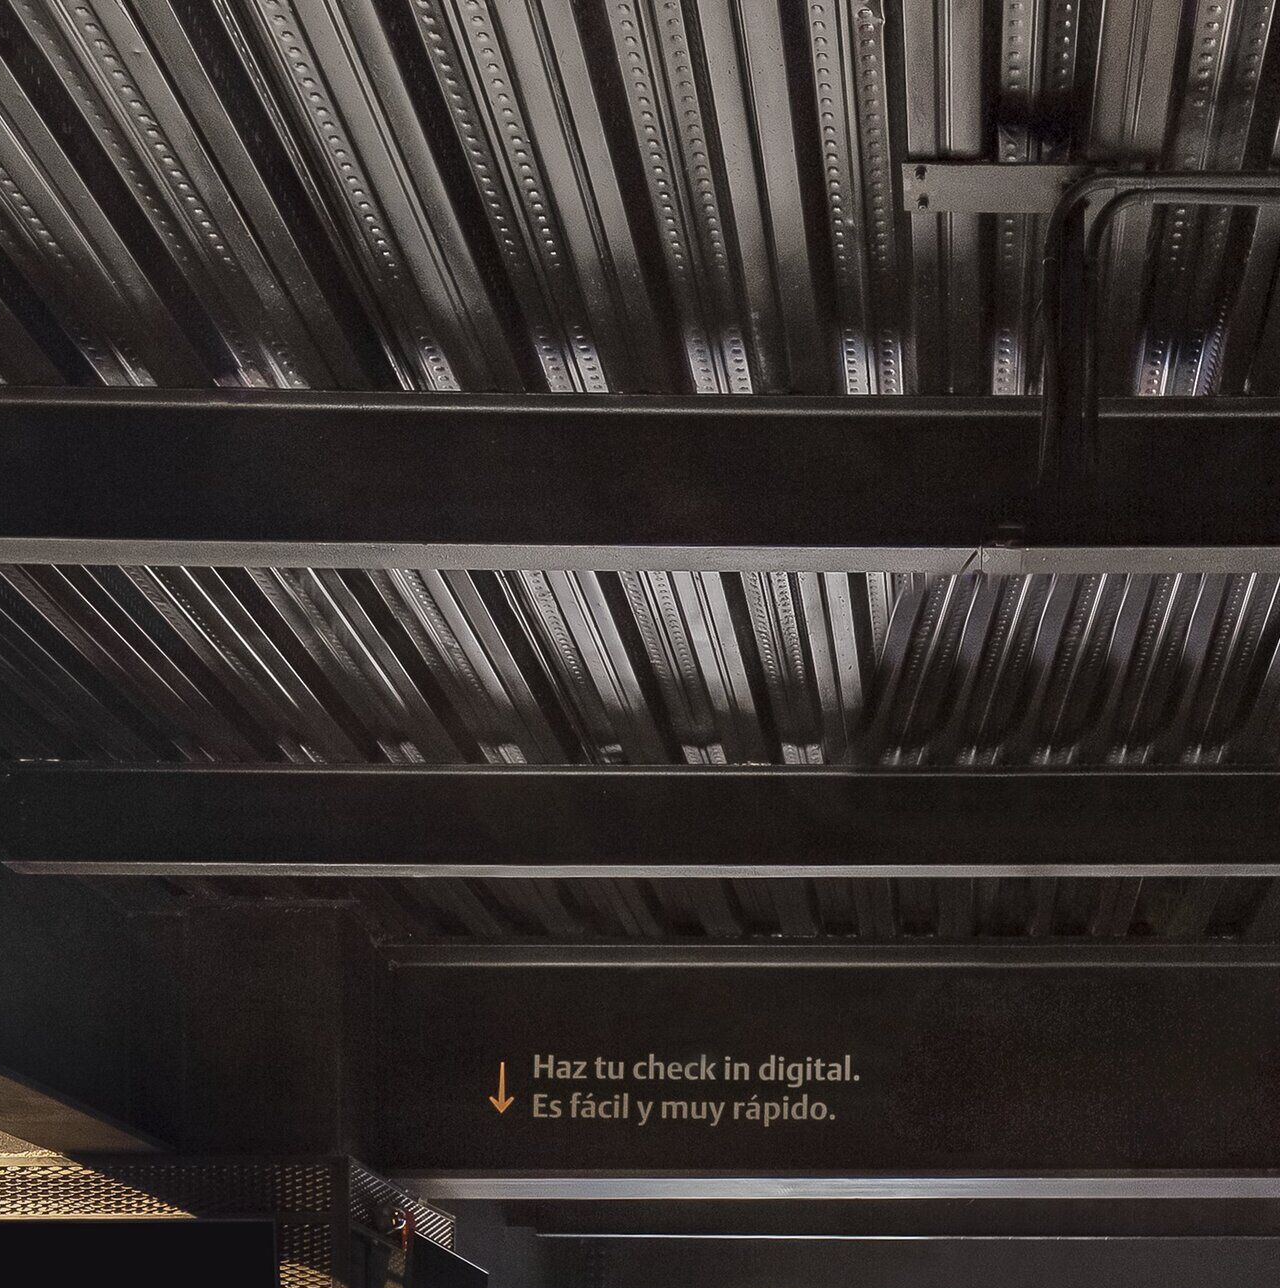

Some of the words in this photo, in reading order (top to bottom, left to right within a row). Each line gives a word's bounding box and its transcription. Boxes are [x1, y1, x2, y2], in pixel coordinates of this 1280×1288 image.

[533, 1054, 587, 1079] Haz
[595, 1056, 624, 1080] tu
[633, 1053, 716, 1081] check
[724, 1055, 750, 1081] in
[758, 1054, 860, 1088] digital.
[533, 1093, 562, 1118] Es
[570, 1093, 629, 1119] fácil
[637, 1100, 653, 1126] y
[661, 1101, 726, 1127] muy
[733, 1094, 836, 1127] rápido.
